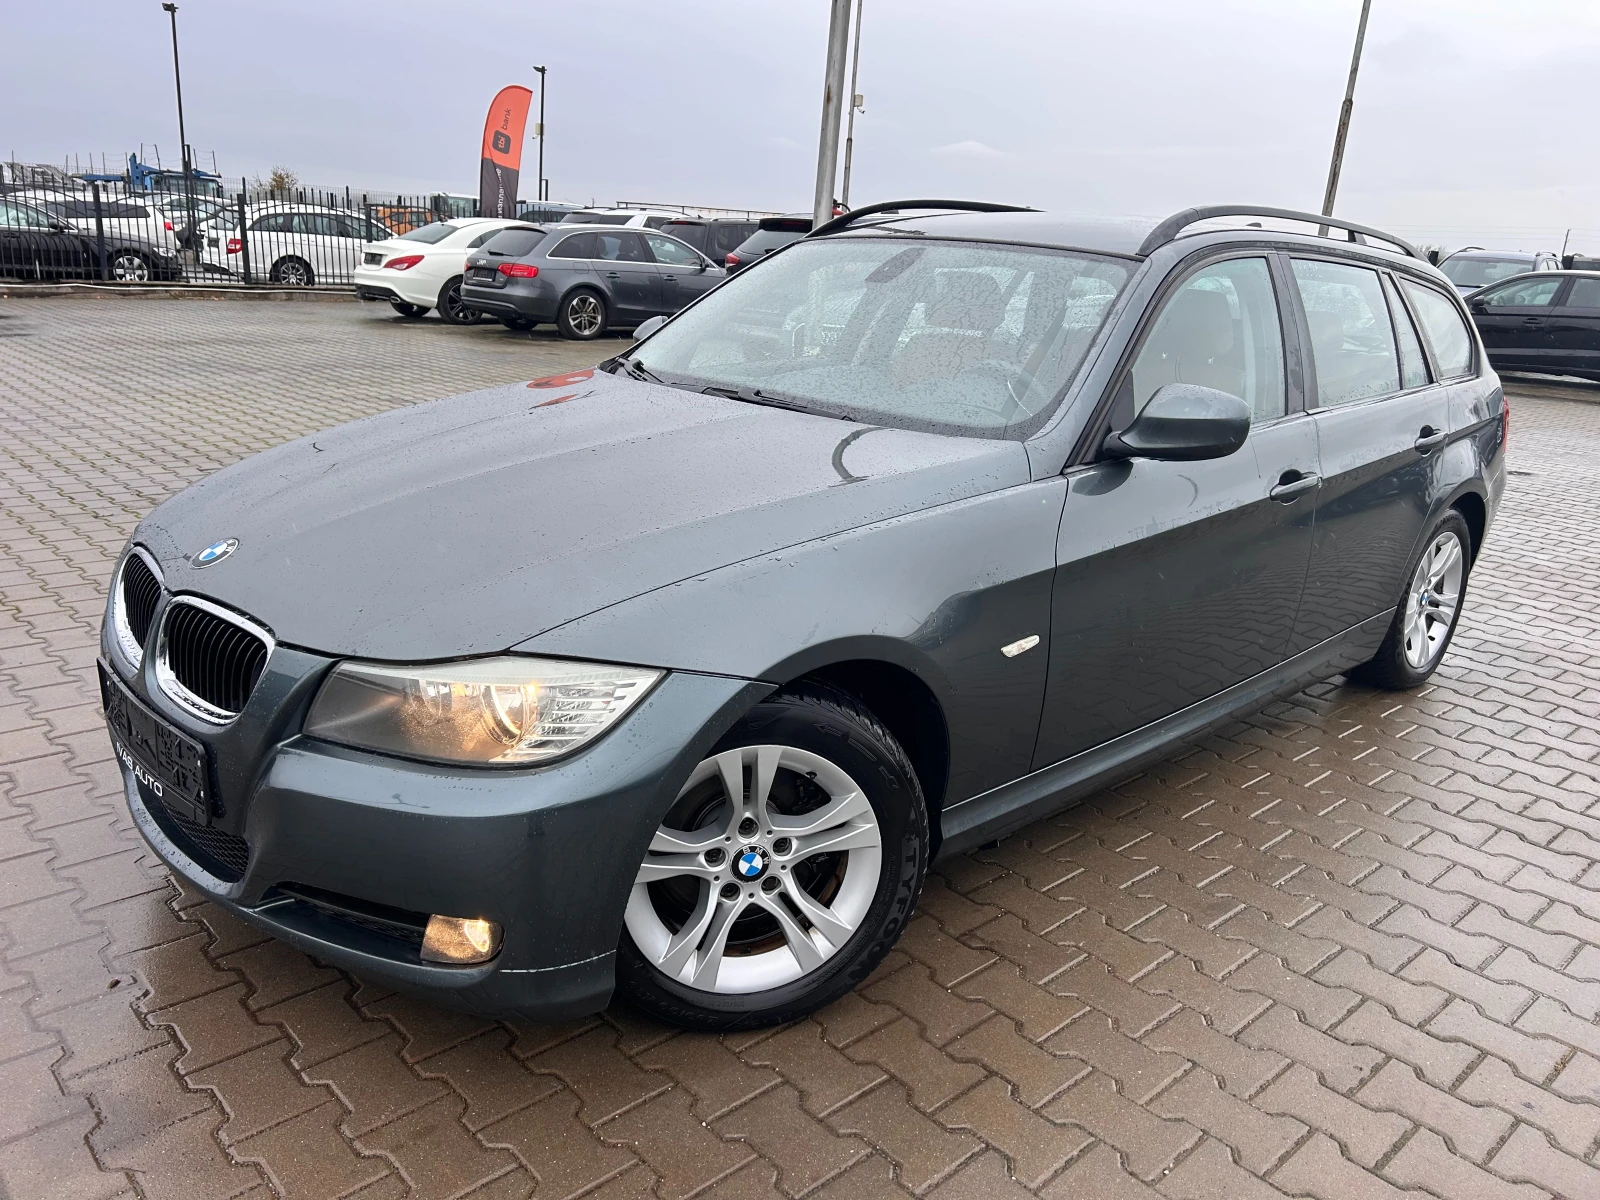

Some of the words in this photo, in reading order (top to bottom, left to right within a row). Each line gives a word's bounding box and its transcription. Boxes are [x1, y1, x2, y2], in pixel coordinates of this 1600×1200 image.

[501, 108, 512, 130] bank
[497, 135, 506, 148] tbi
[134, 765, 163, 797] AUTO
[742, 846, 770, 865] BMW
